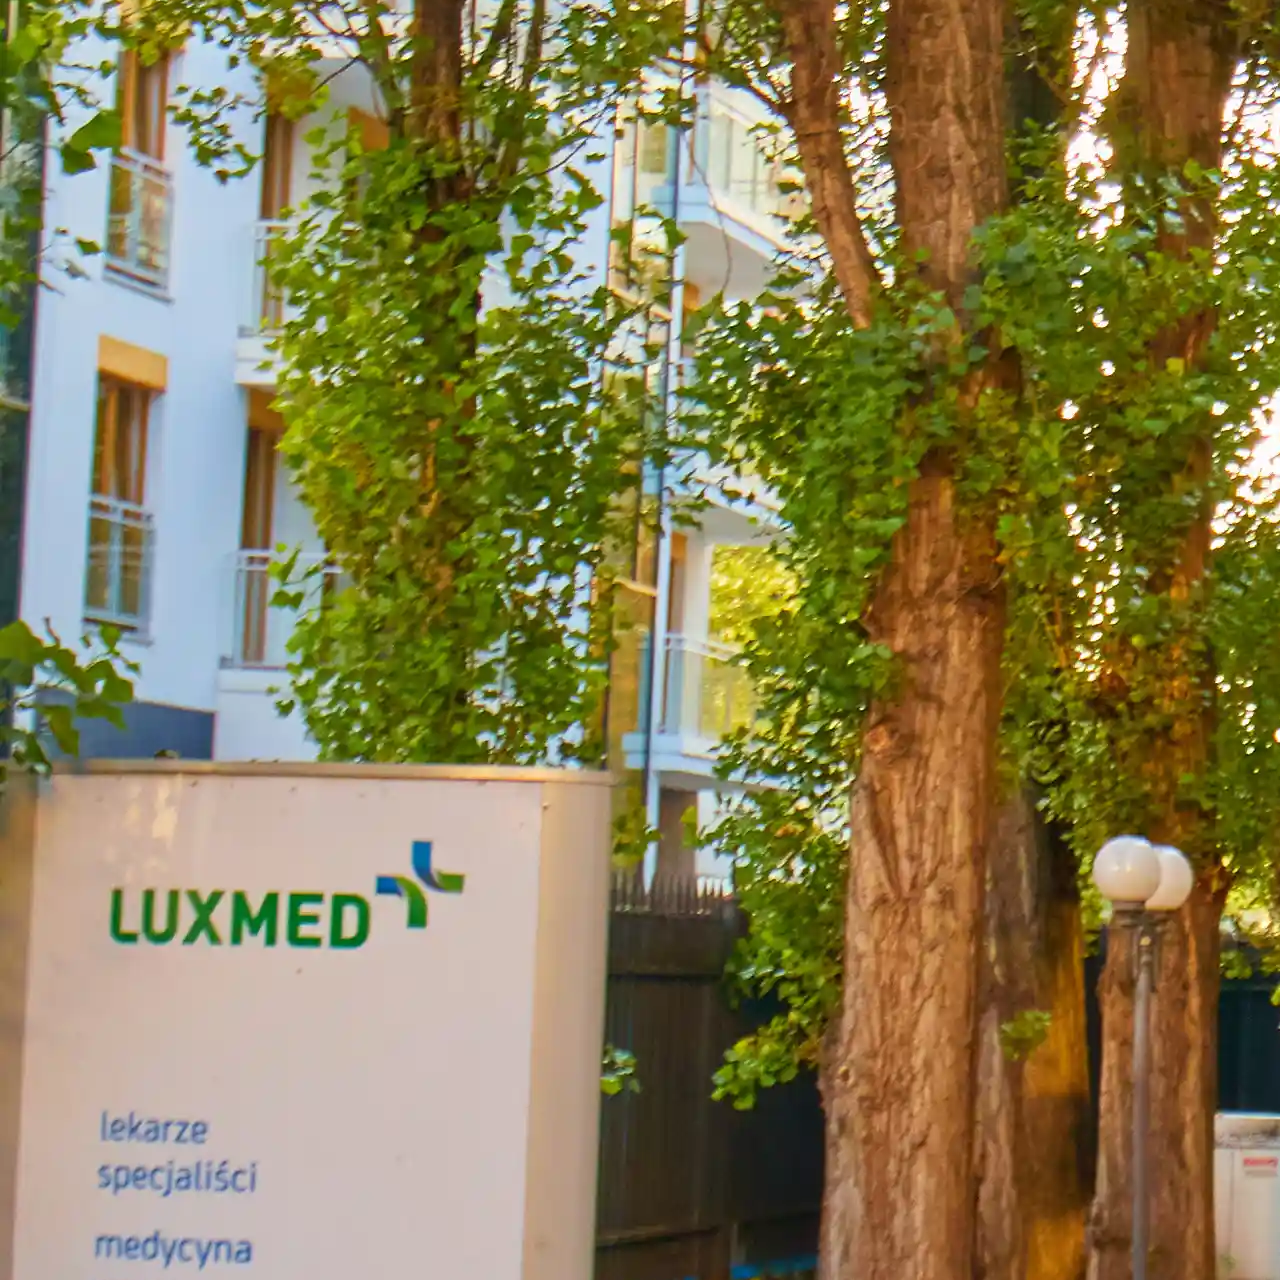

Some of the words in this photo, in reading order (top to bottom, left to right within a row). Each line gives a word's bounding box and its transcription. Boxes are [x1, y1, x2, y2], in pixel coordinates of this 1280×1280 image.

[109, 886, 372, 950] LUXMED
[100, 1109, 209, 1145] lekarze
[97, 1159, 257, 1198] specjaliści
[94, 1229, 253, 1271] medycyna
